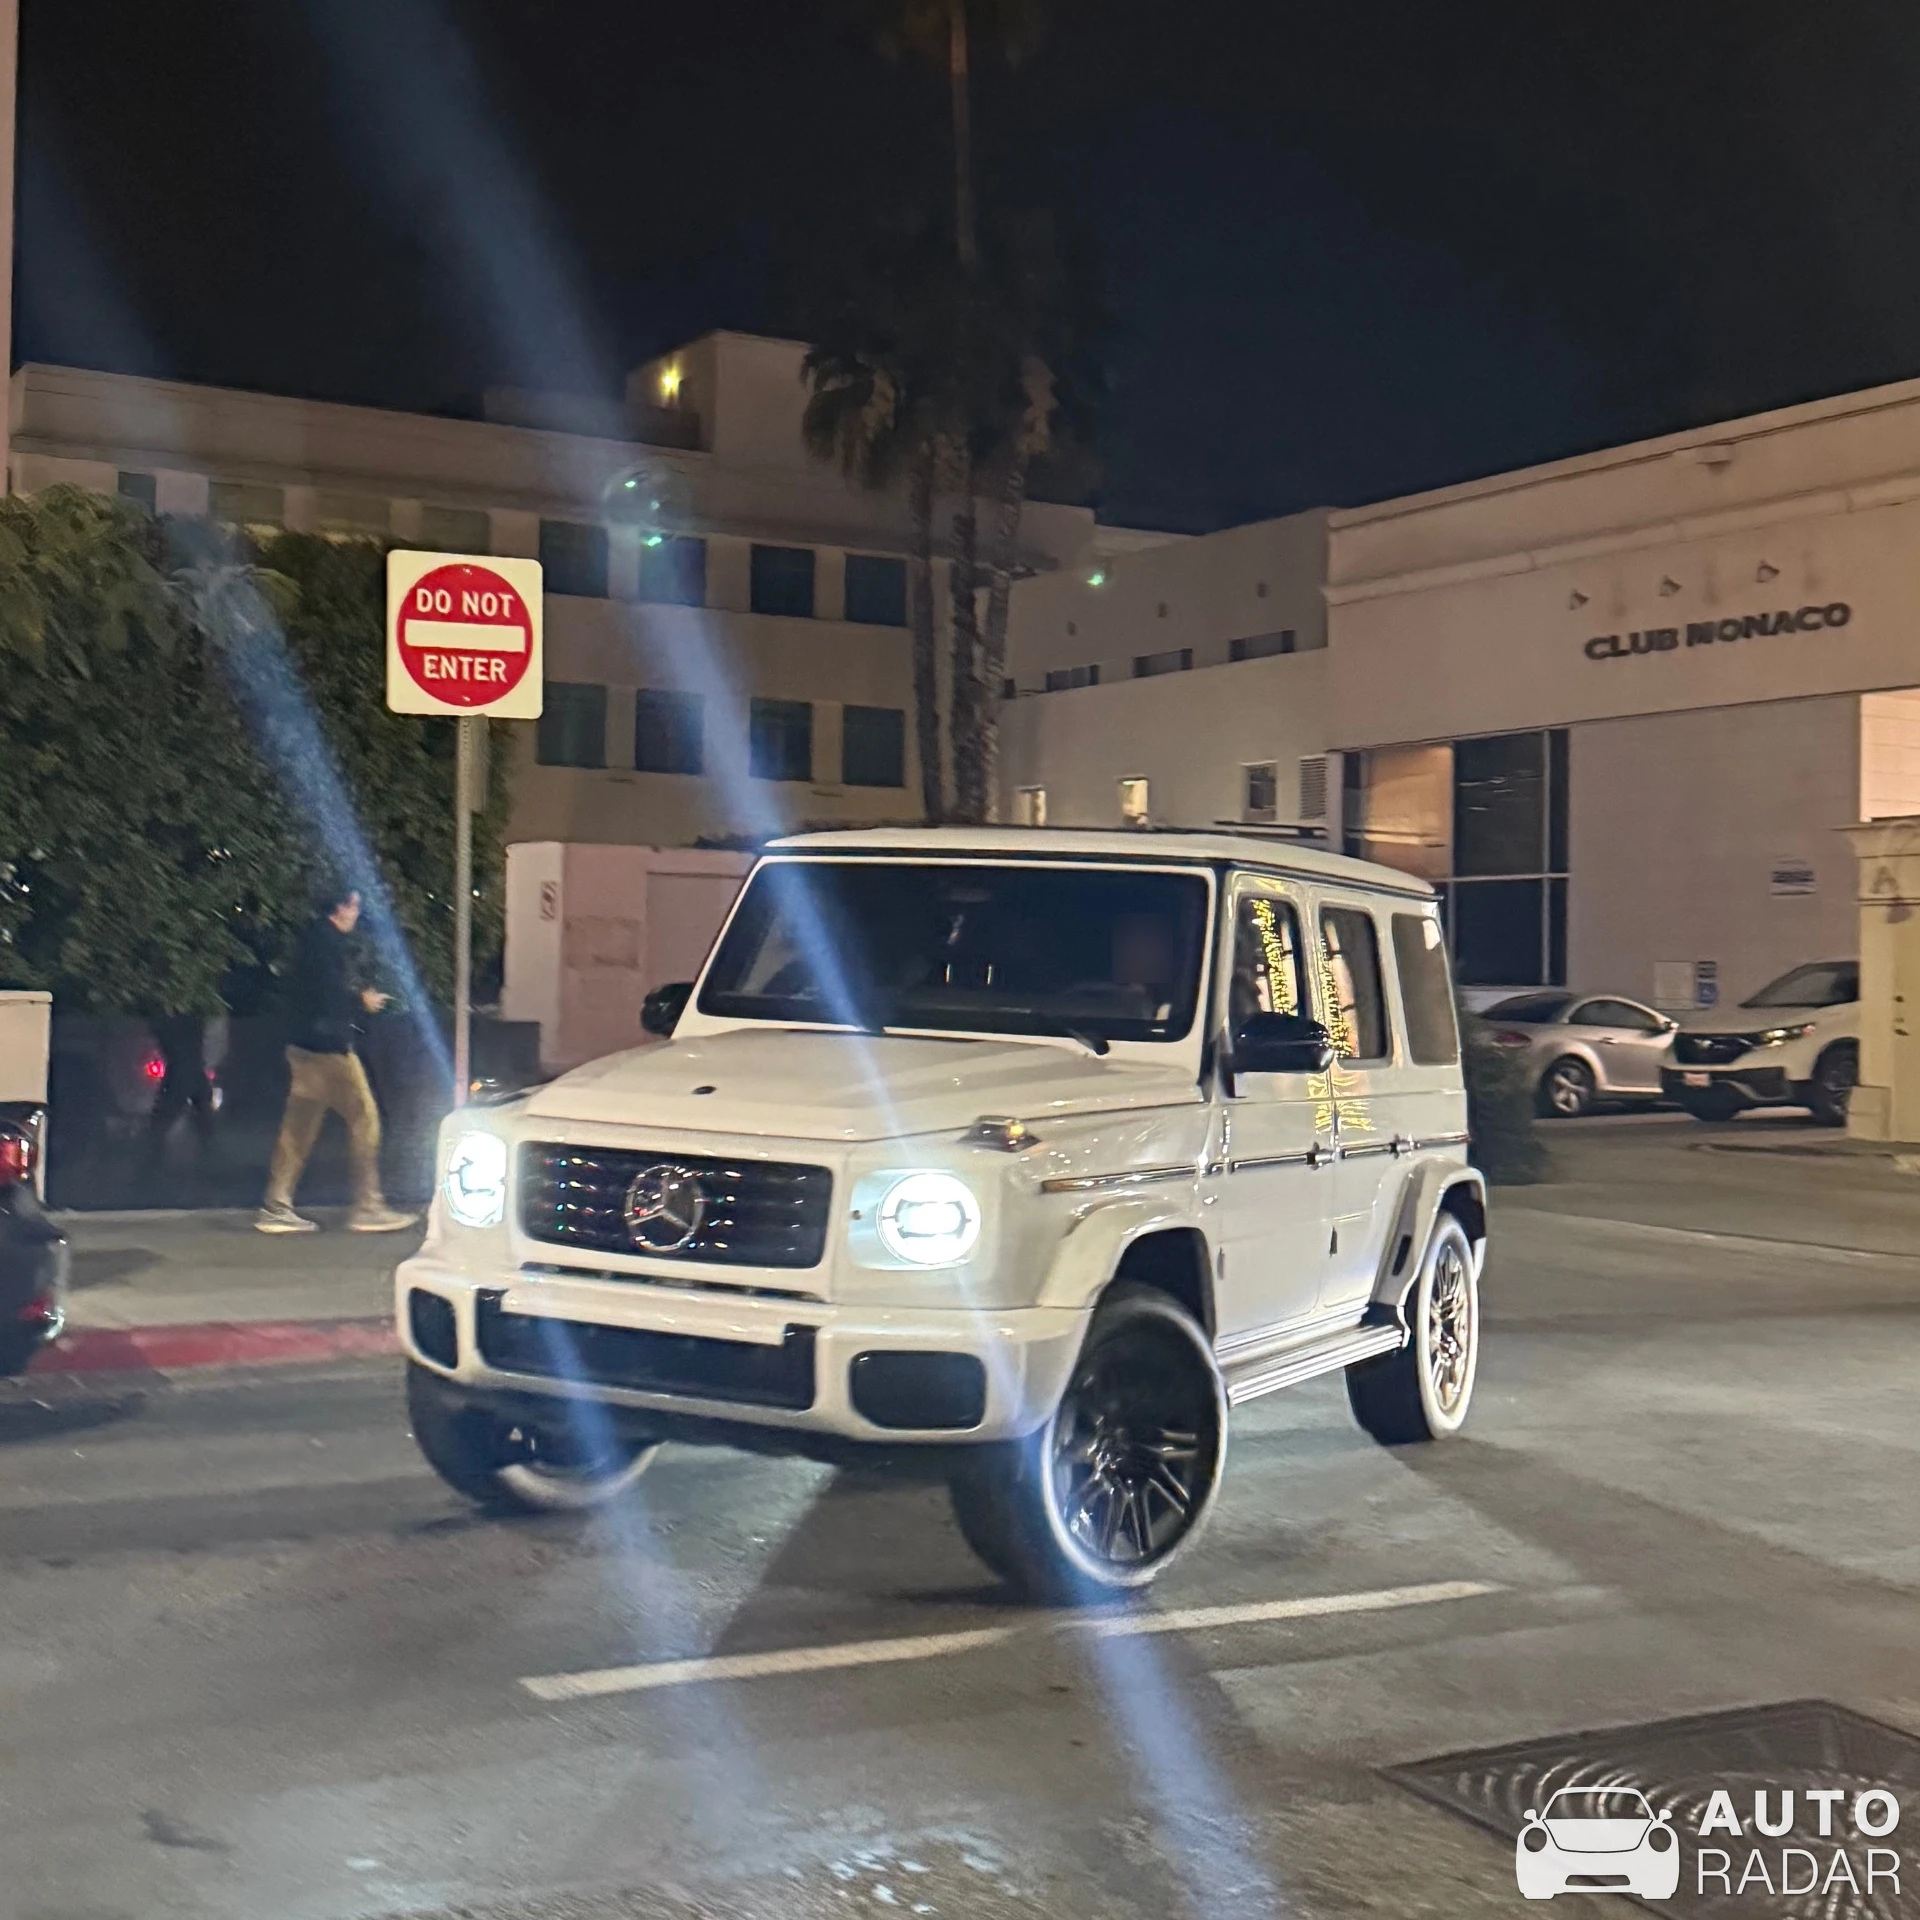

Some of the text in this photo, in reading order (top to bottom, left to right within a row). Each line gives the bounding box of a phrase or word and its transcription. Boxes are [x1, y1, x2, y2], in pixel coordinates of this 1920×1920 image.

[416, 588, 514, 618] DO NOT
[1584, 602, 1851, 660] CLUB MONACO
[423, 653, 508, 683] ENTER
